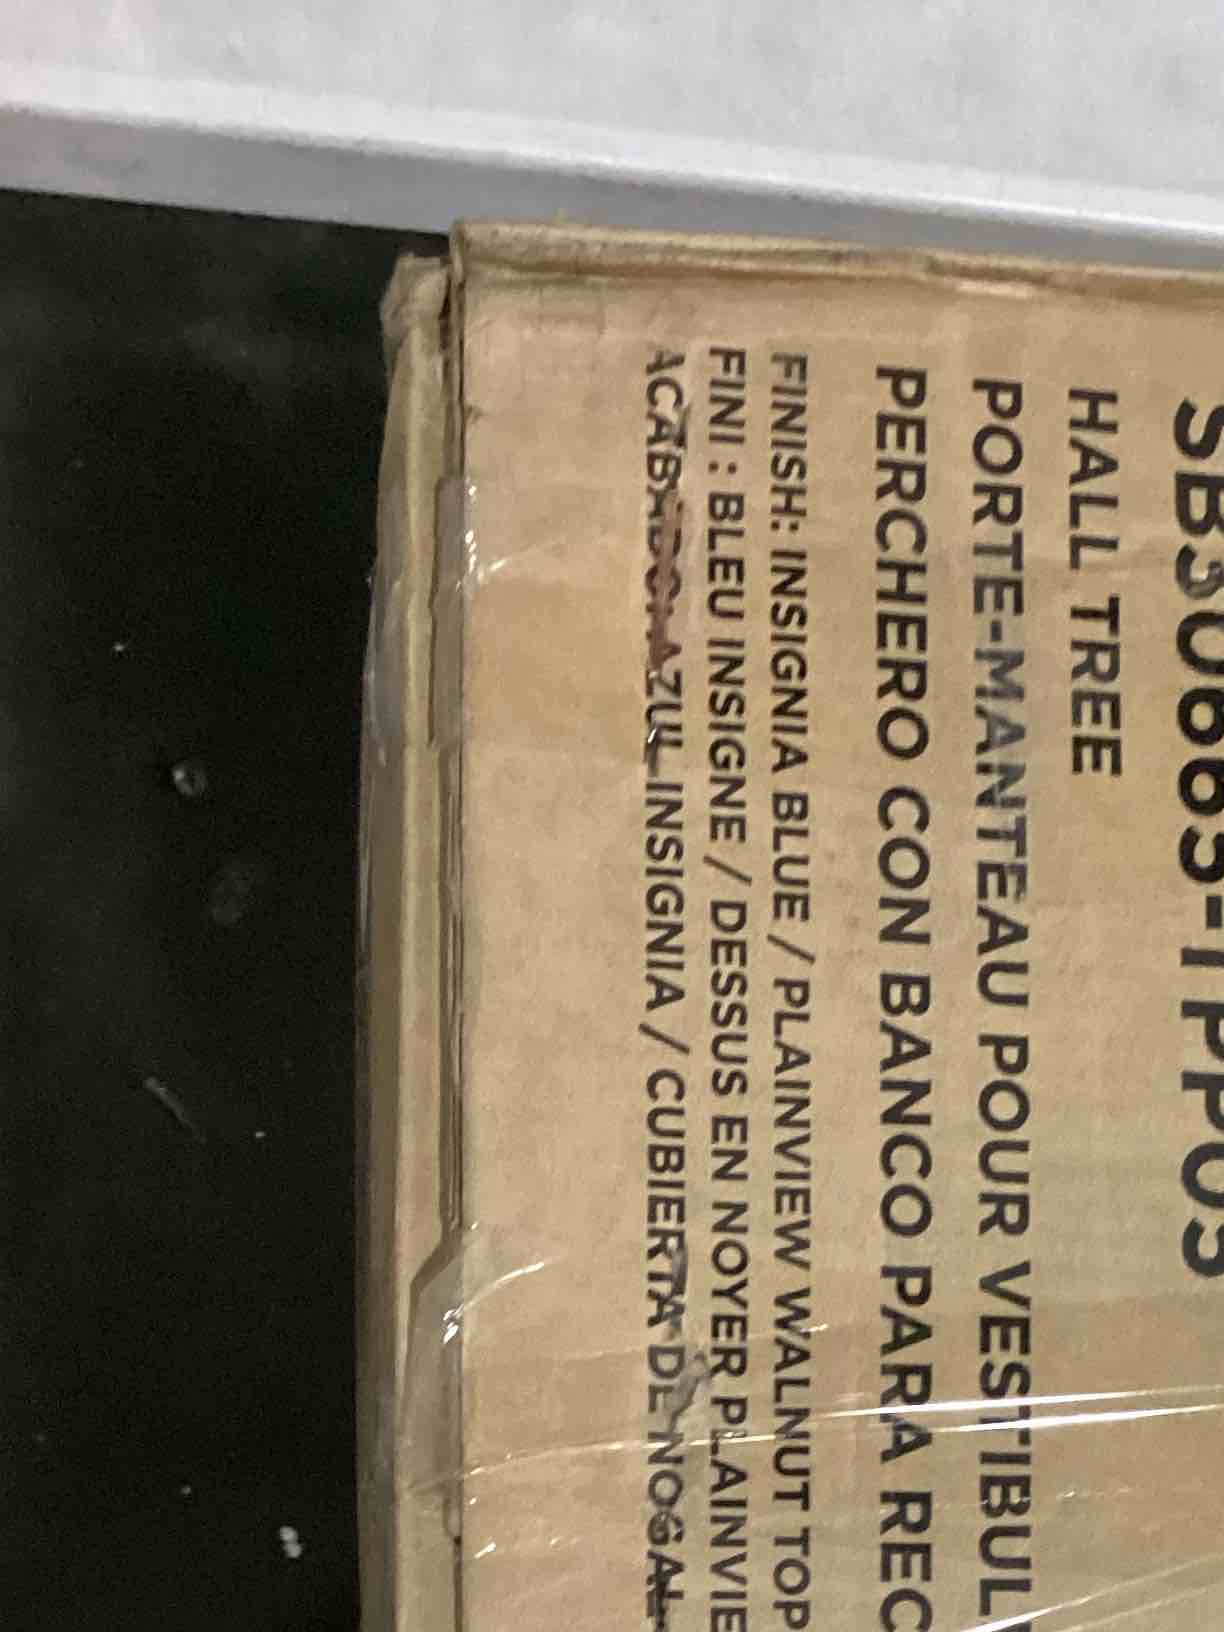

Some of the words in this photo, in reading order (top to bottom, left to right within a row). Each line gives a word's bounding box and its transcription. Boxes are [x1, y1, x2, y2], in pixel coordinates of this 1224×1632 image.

[709, 348, 746, 444] FINI
[771, 354, 808, 532] FINISH:
[1069, 389, 1118, 570] HALL
[708, 492, 744, 620] BLEU
[875, 366, 929, 760] PERCHERO
[708, 639, 746, 843] INSIGNE
[771, 550, 808, 773] INSIGNIA
[973, 379, 1028, 1006] PORTE-MANTEAU
[1071, 596, 1122, 777] TREE
[646, 782, 685, 1011] INSIGNIA
[704, 856, 752, 885] /
[772, 792, 810, 922] BLUE
[878, 786, 930, 944] CON
[639, 1024, 690, 1054] /
[711, 901, 748, 1096] DESSUS
[767, 934, 815, 964] /
[711, 1115, 748, 1181] EN
[774, 978, 811, 1270] PLAINVIEW
[880, 973, 933, 1238] BANCO
[979, 1034, 1030, 1236] POUR
[647, 1069, 686, 1330] CUBIERTA
[647, 1344, 686, 1413] DE
[710, 1202, 748, 1380] NOYER
[880, 1266, 933, 1464] PARA
[773, 1287, 811, 1512] WALNUT
[646, 1431, 685, 1618] NOGAL
[773, 1527, 810, 1630] TOP
